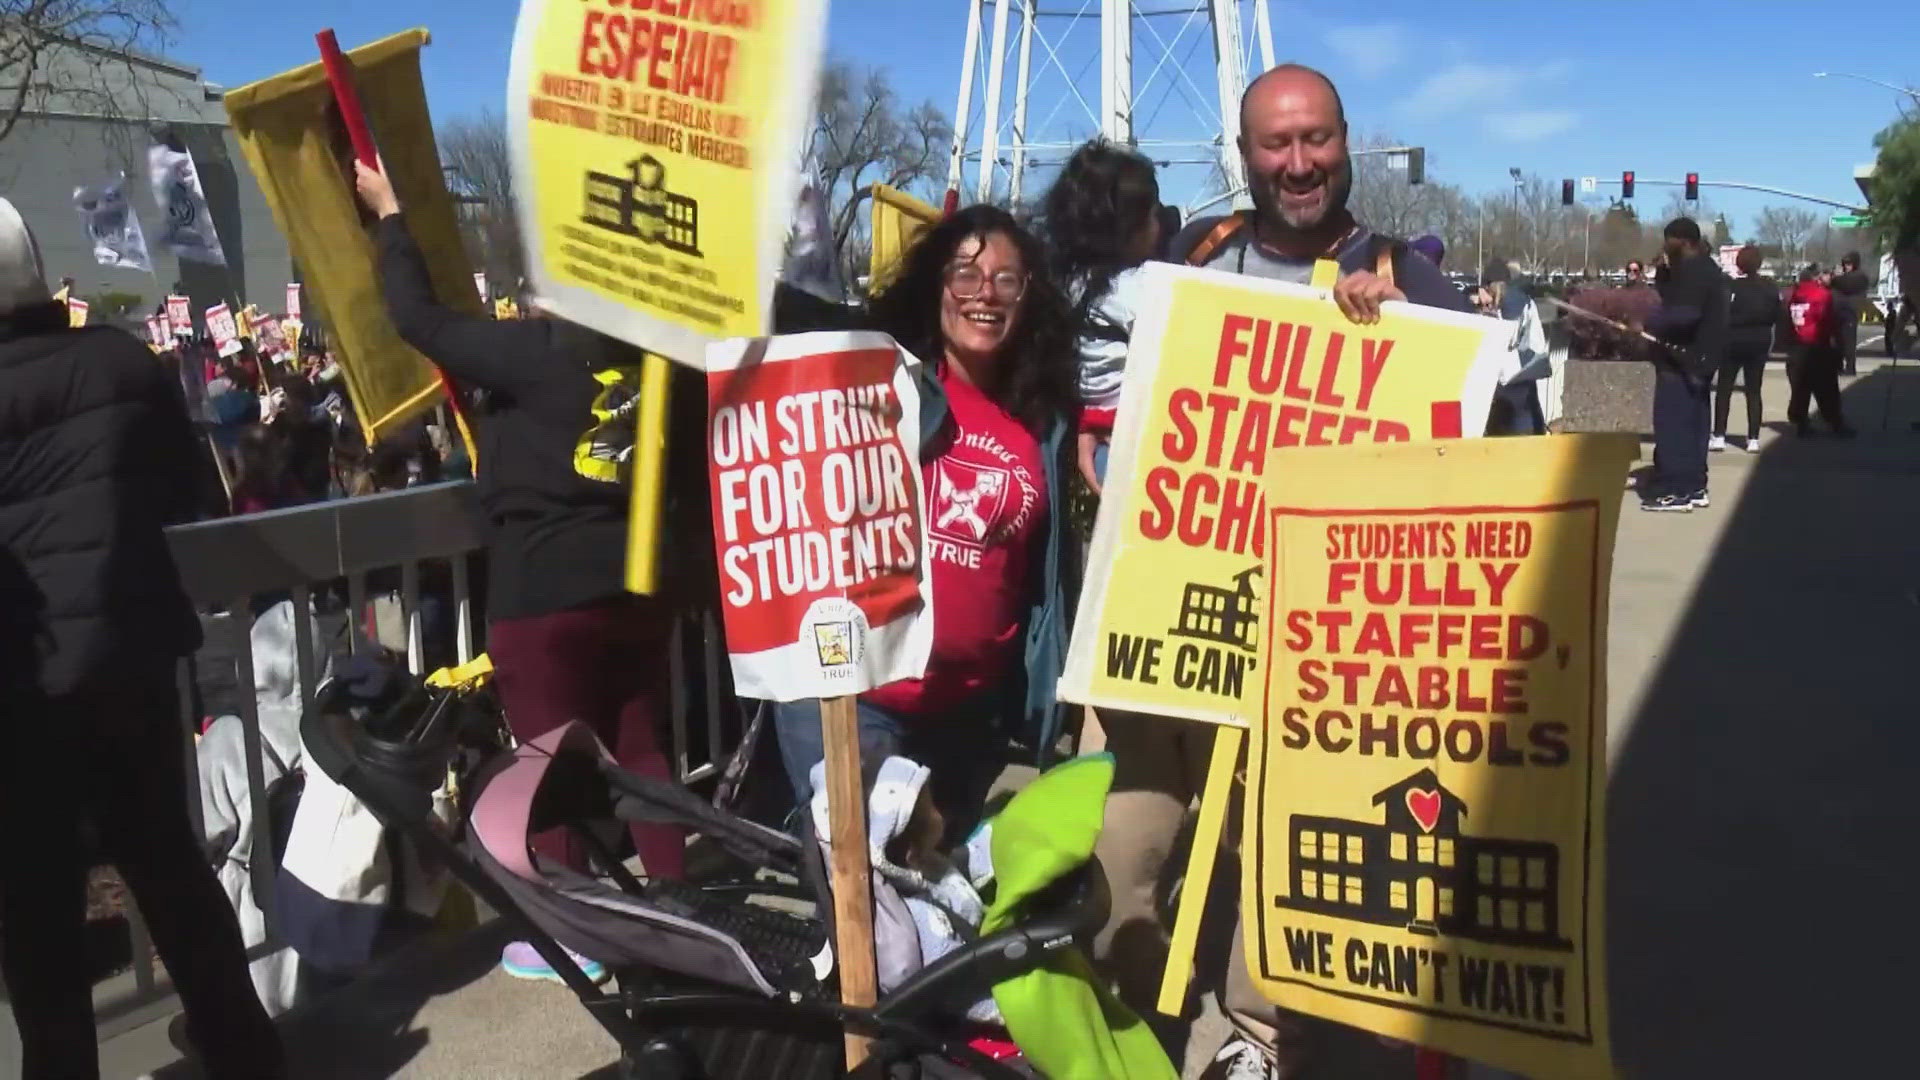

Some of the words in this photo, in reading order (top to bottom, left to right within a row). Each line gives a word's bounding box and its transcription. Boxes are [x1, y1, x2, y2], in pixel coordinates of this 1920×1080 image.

[1213, 313, 1395, 412] FULLY
[713, 401, 770, 467] ON
[775, 383, 894, 458] STRIKE
[719, 459, 812, 542] FOR
[821, 443, 909, 523] OUR
[723, 513, 915, 608] STUDENTS
[929, 540, 982, 569] TRUE
[1325, 522, 1456, 559] STUDENTS
[1465, 521, 1533, 559] NEED
[1327, 562, 1520, 607] FULLY
[1106, 632, 1163, 685] WE
[1297, 659, 1529, 714] STABLE
[1282, 707, 1570, 767] SCHOOLS
[1283, 926, 1335, 979] WE
[1345, 937, 1448, 1003] CAN'T
[1458, 954, 1566, 1025] WAIT!
